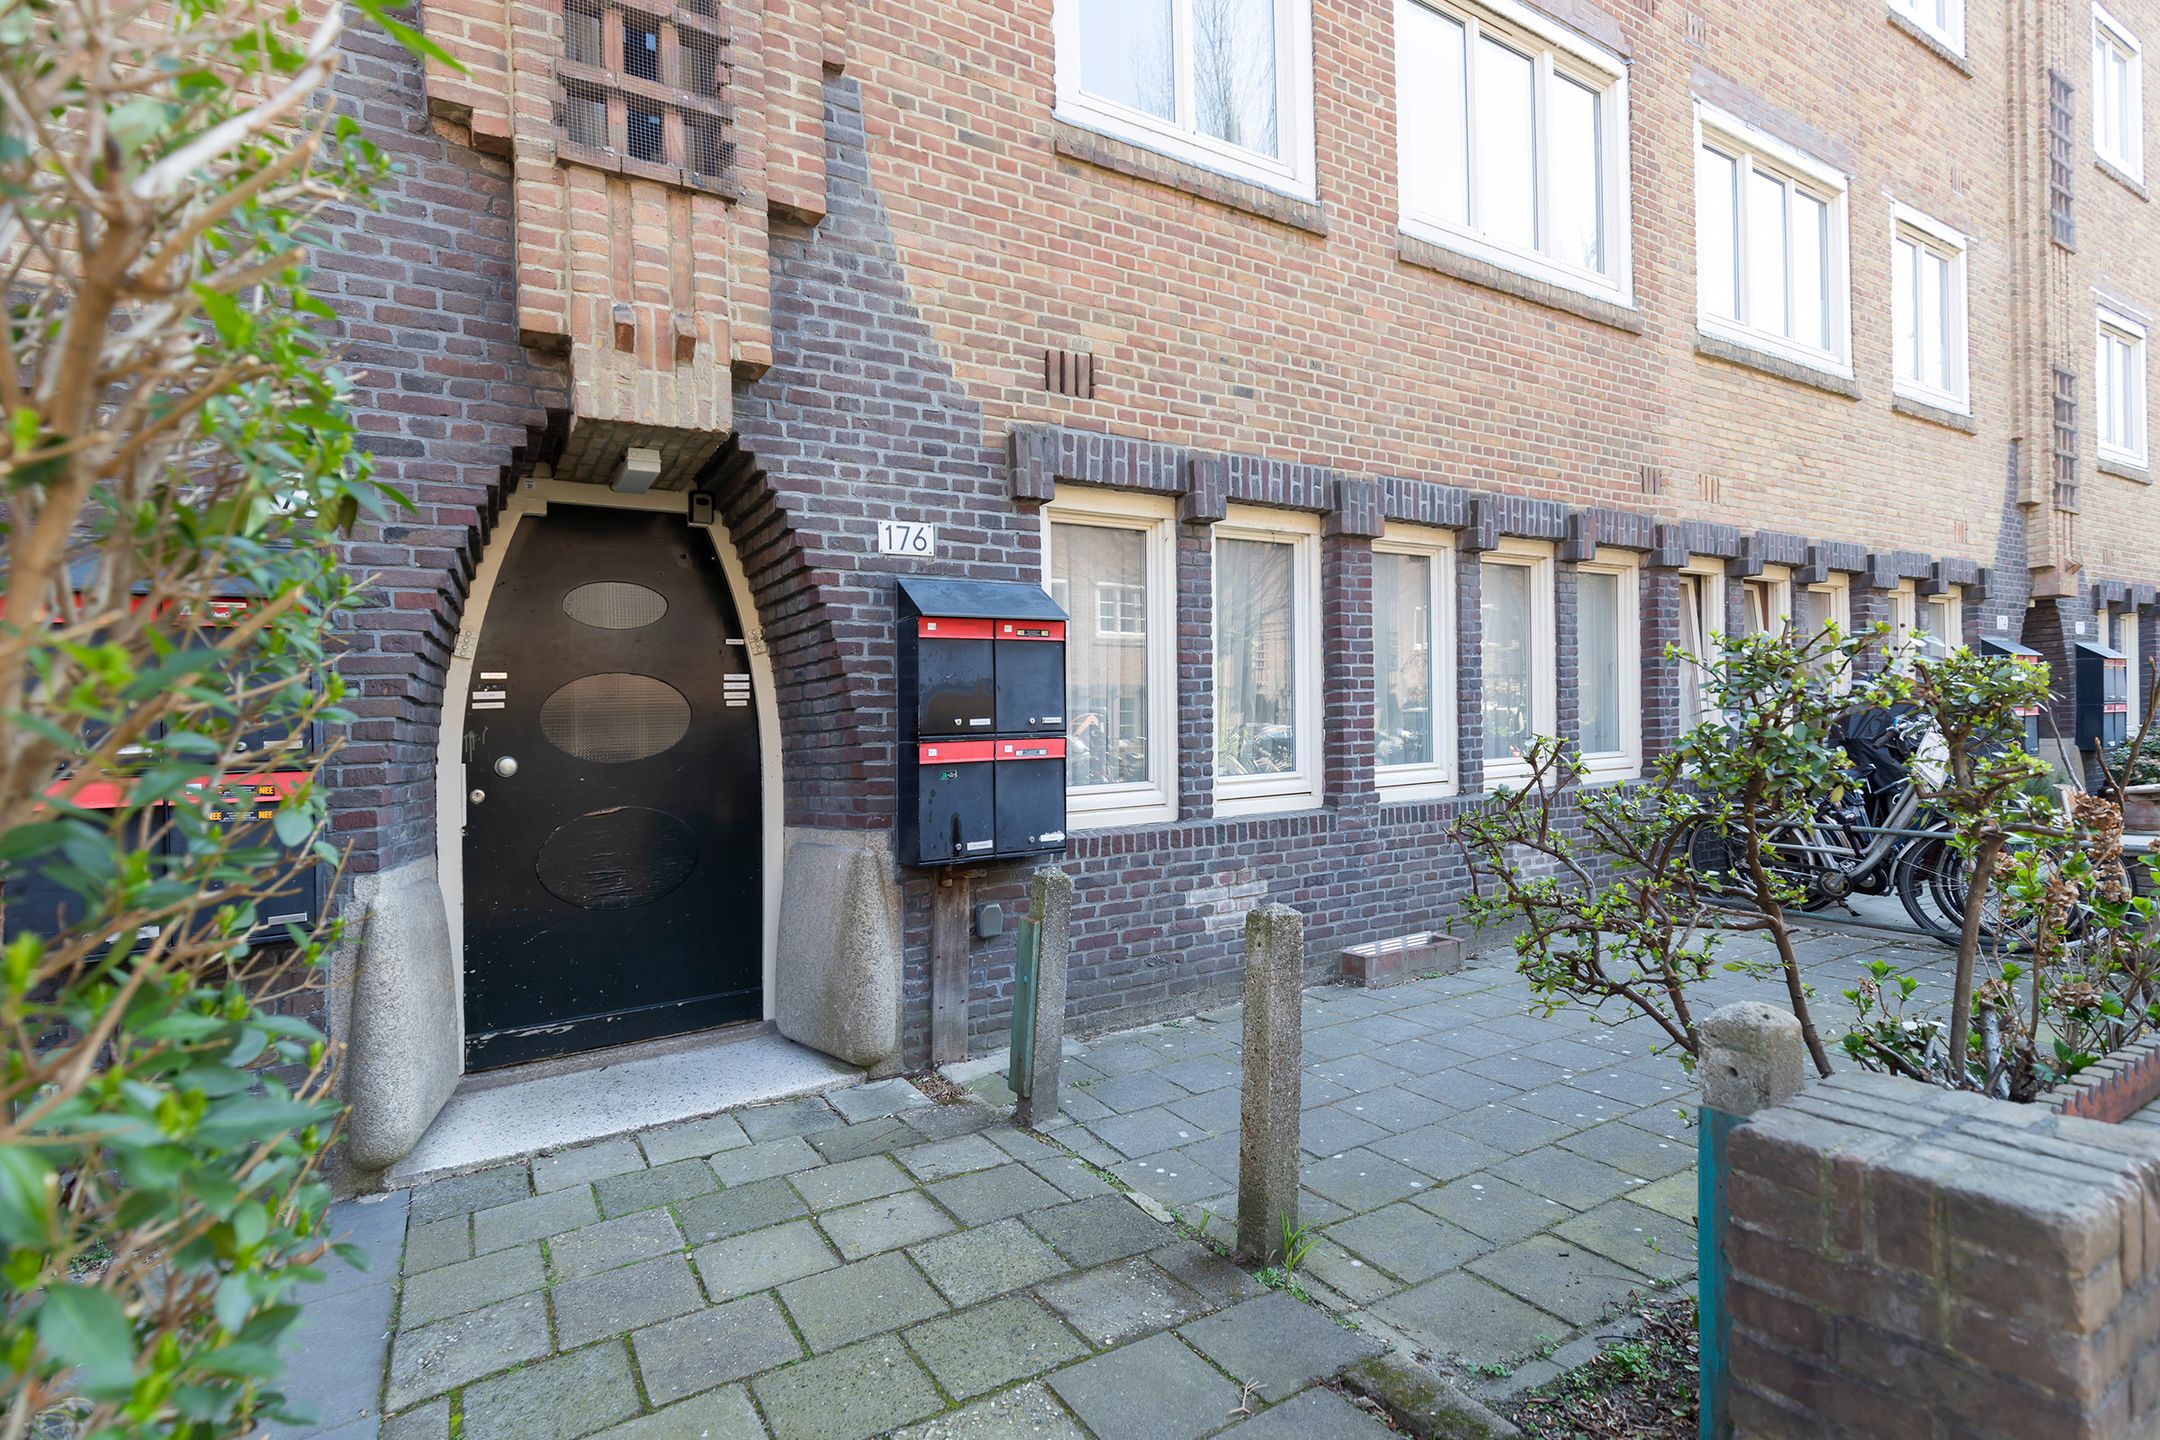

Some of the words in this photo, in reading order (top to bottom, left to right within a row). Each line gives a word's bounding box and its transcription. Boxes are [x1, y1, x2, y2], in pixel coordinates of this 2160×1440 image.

[885, 524, 927, 551] 176
[258, 786, 274, 795] NEE
[258, 810, 273, 819] NEE
